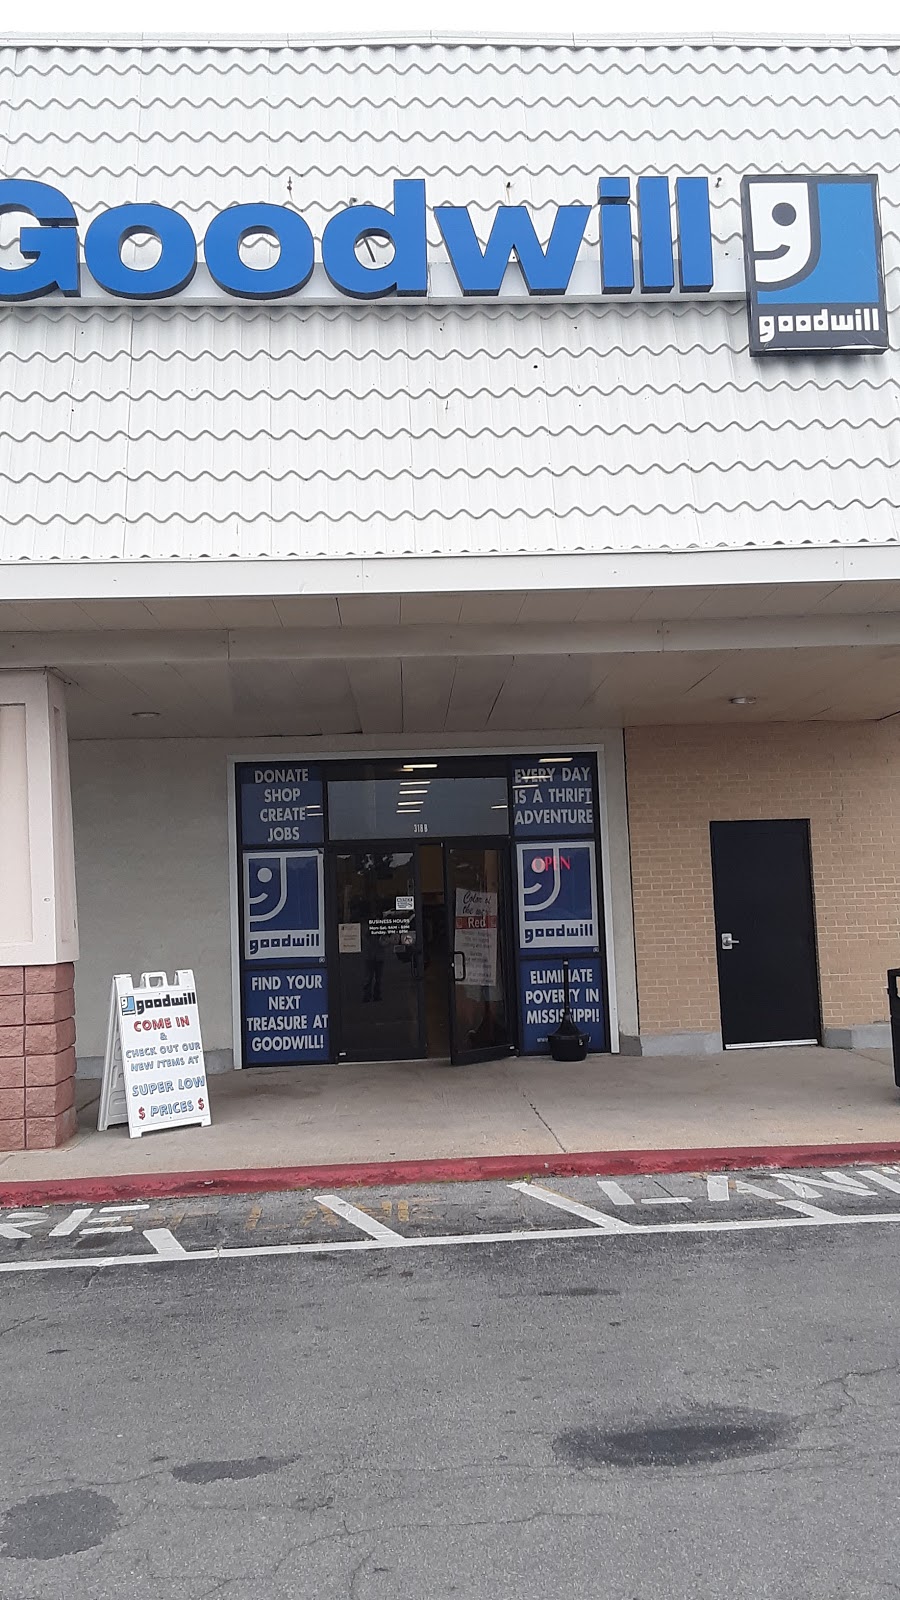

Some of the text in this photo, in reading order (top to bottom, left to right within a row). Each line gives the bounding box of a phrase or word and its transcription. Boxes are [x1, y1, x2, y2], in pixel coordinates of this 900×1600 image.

[0, 177, 713, 302] Goodwill
[758, 308, 879, 343] goodwill
[254, 768, 309, 784] DONATE
[514, 766, 590, 784] EVERY DAY
[264, 787, 301, 803] SHOP
[514, 787, 592, 804] IS A THRIFT
[259, 806, 306, 823] CREATE
[514, 808, 593, 825] ADVENTURE
[267, 826, 300, 843] JOBS
[467, 916, 486, 929] Red
[524, 924, 593, 943] goodwill
[249, 933, 319, 955] goodwill
[251, 974, 323, 991] FIND YOUR
[136, 992, 196, 1014] goodwill
[268, 995, 301, 1011] NEXT
[585, 988, 599, 1003] IN
[133, 1015, 190, 1033] COME IN
[246, 1014, 329, 1032] TREASURE AT
[526, 1008, 600, 1025] MISSISIPPI!
[159, 1032, 168, 1041] &
[251, 1034, 324, 1052] GOODWILL!
[125, 1042, 201, 1059] CHECK OUT OUR
[130, 1055, 199, 1072] NEW ITEMS AT
[132, 1075, 205, 1097] SUPER LOW
[138, 1098, 205, 1120] $ PRICES $
